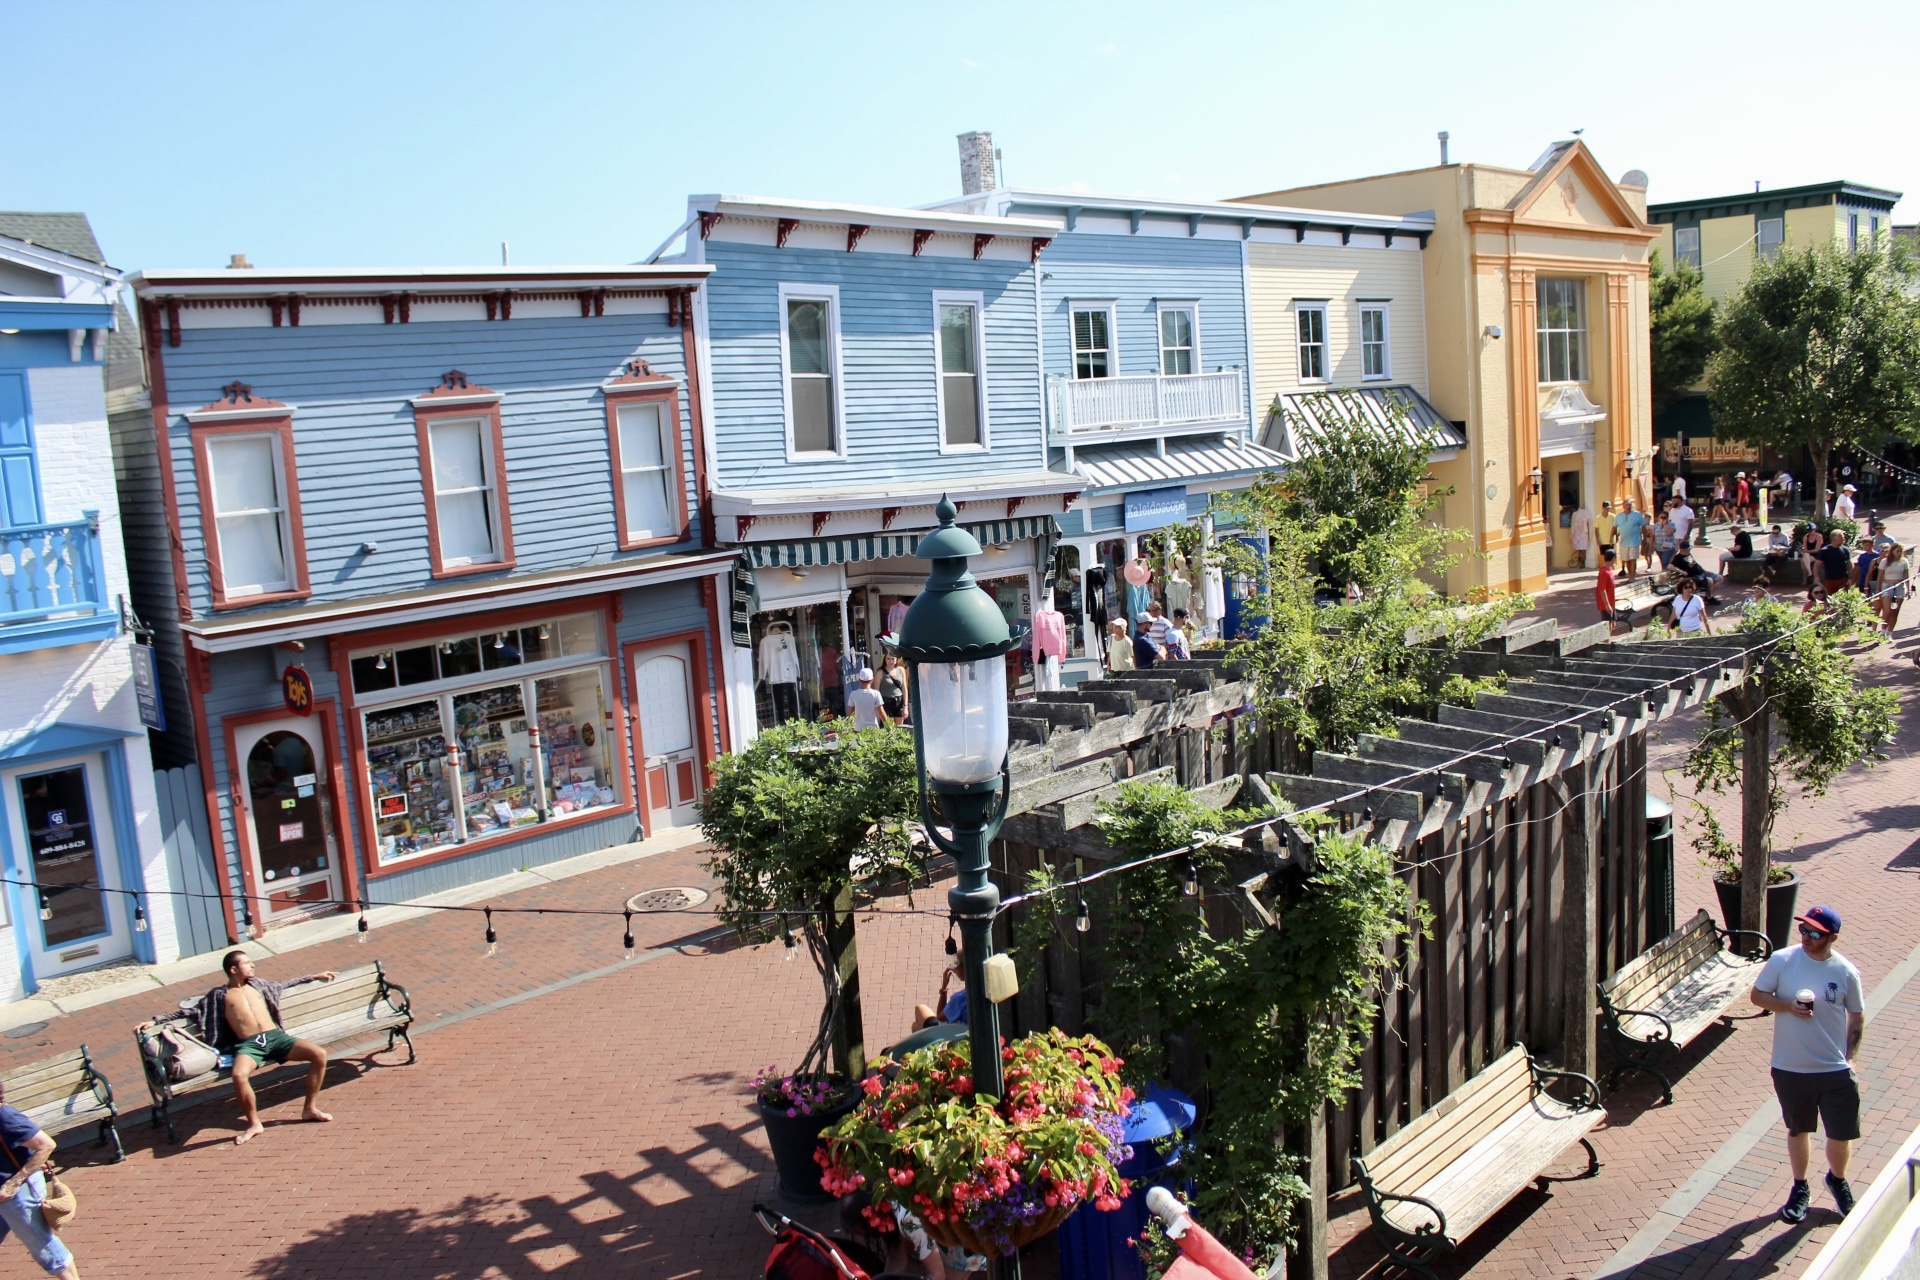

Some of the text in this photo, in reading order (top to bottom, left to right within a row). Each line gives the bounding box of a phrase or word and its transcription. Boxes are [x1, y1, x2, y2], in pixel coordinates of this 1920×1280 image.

[1683, 445, 1739, 457] UGLY MUG
[1127, 500, 1186, 518] Kaleidoscope
